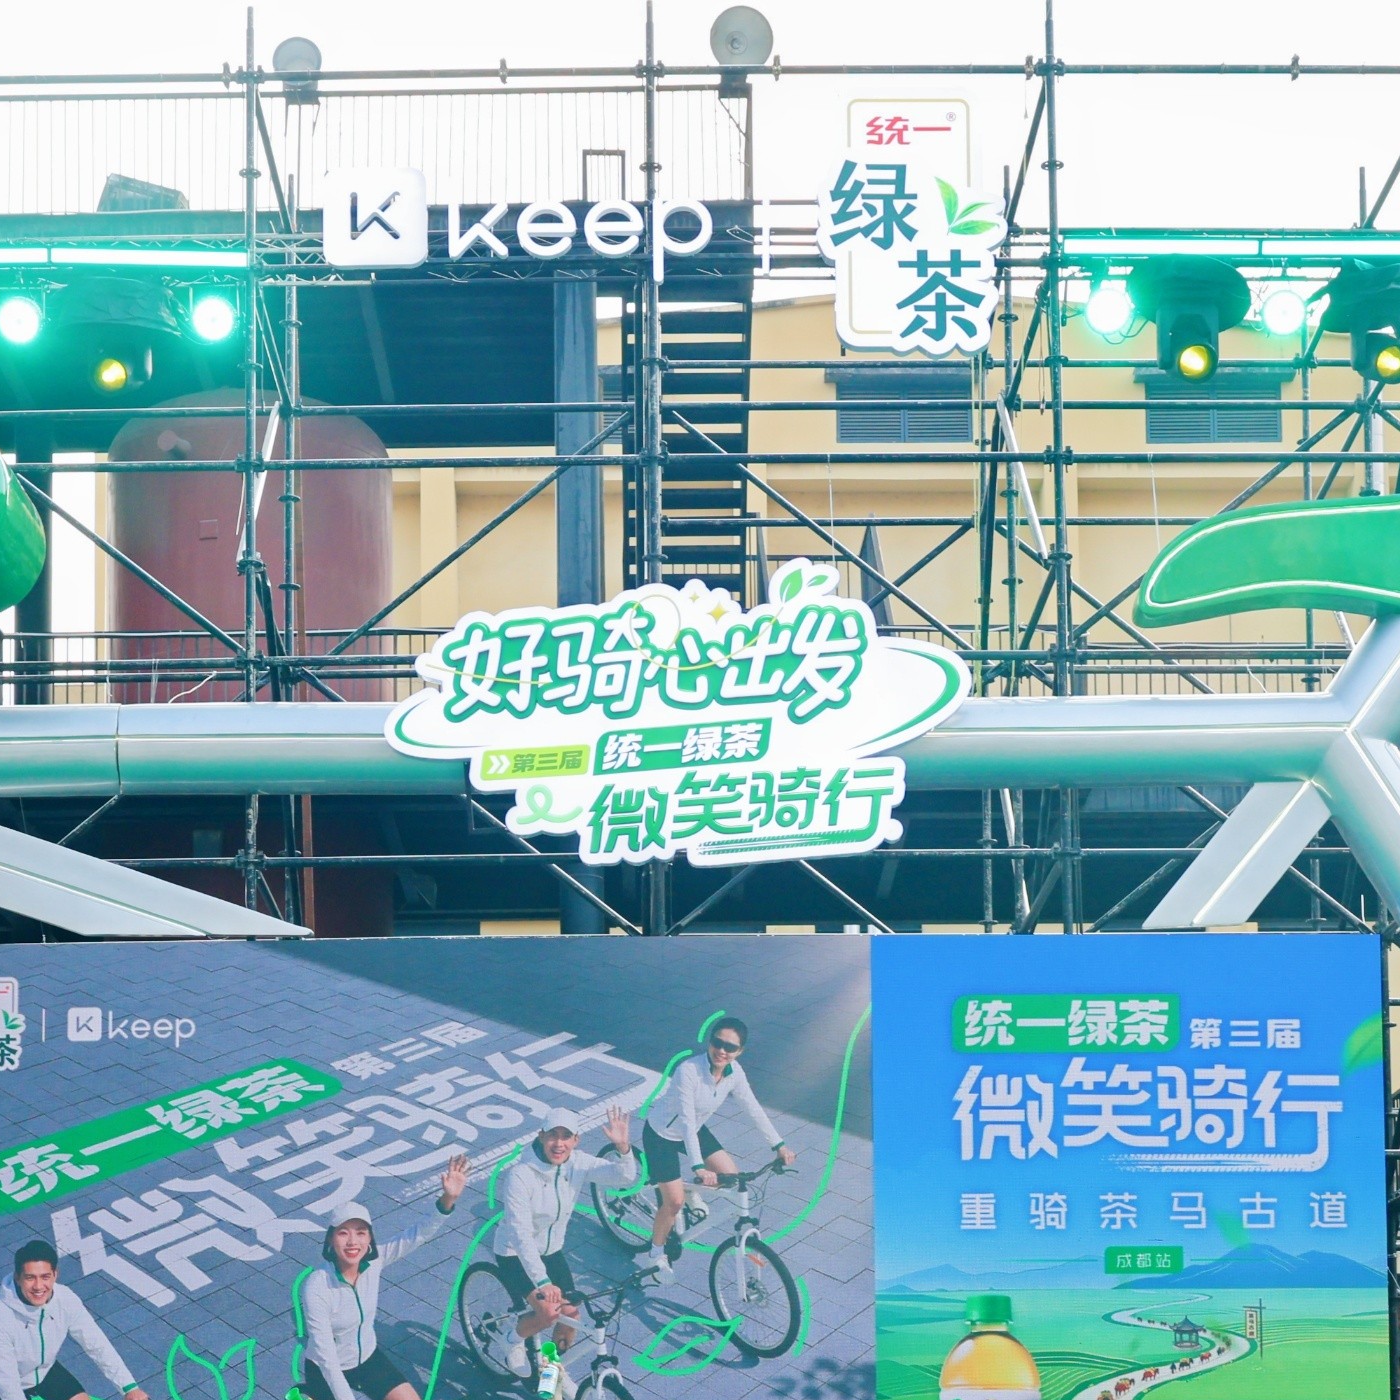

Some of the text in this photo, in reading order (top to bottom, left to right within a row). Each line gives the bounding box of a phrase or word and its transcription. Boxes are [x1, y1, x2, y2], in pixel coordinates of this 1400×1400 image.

[866, 116, 952, 146] 统一
[448, 198, 713, 284] keep
[829, 159, 986, 341] 绿茶
[512, 723, 762, 775] 第三届 统一绿茶
[588, 766, 901, 855] 微笑骑行
[108, 1010, 196, 1048] keep
[330, 1021, 488, 1081] 第三届
[964, 1000, 1302, 1051] 统一绿茶 第三届
[952, 1056, 1344, 1173] 微笑骑行
[959, 1190, 1349, 1231] 重骑茶马古道
[1115, 1252, 1172, 1269] 成都站
